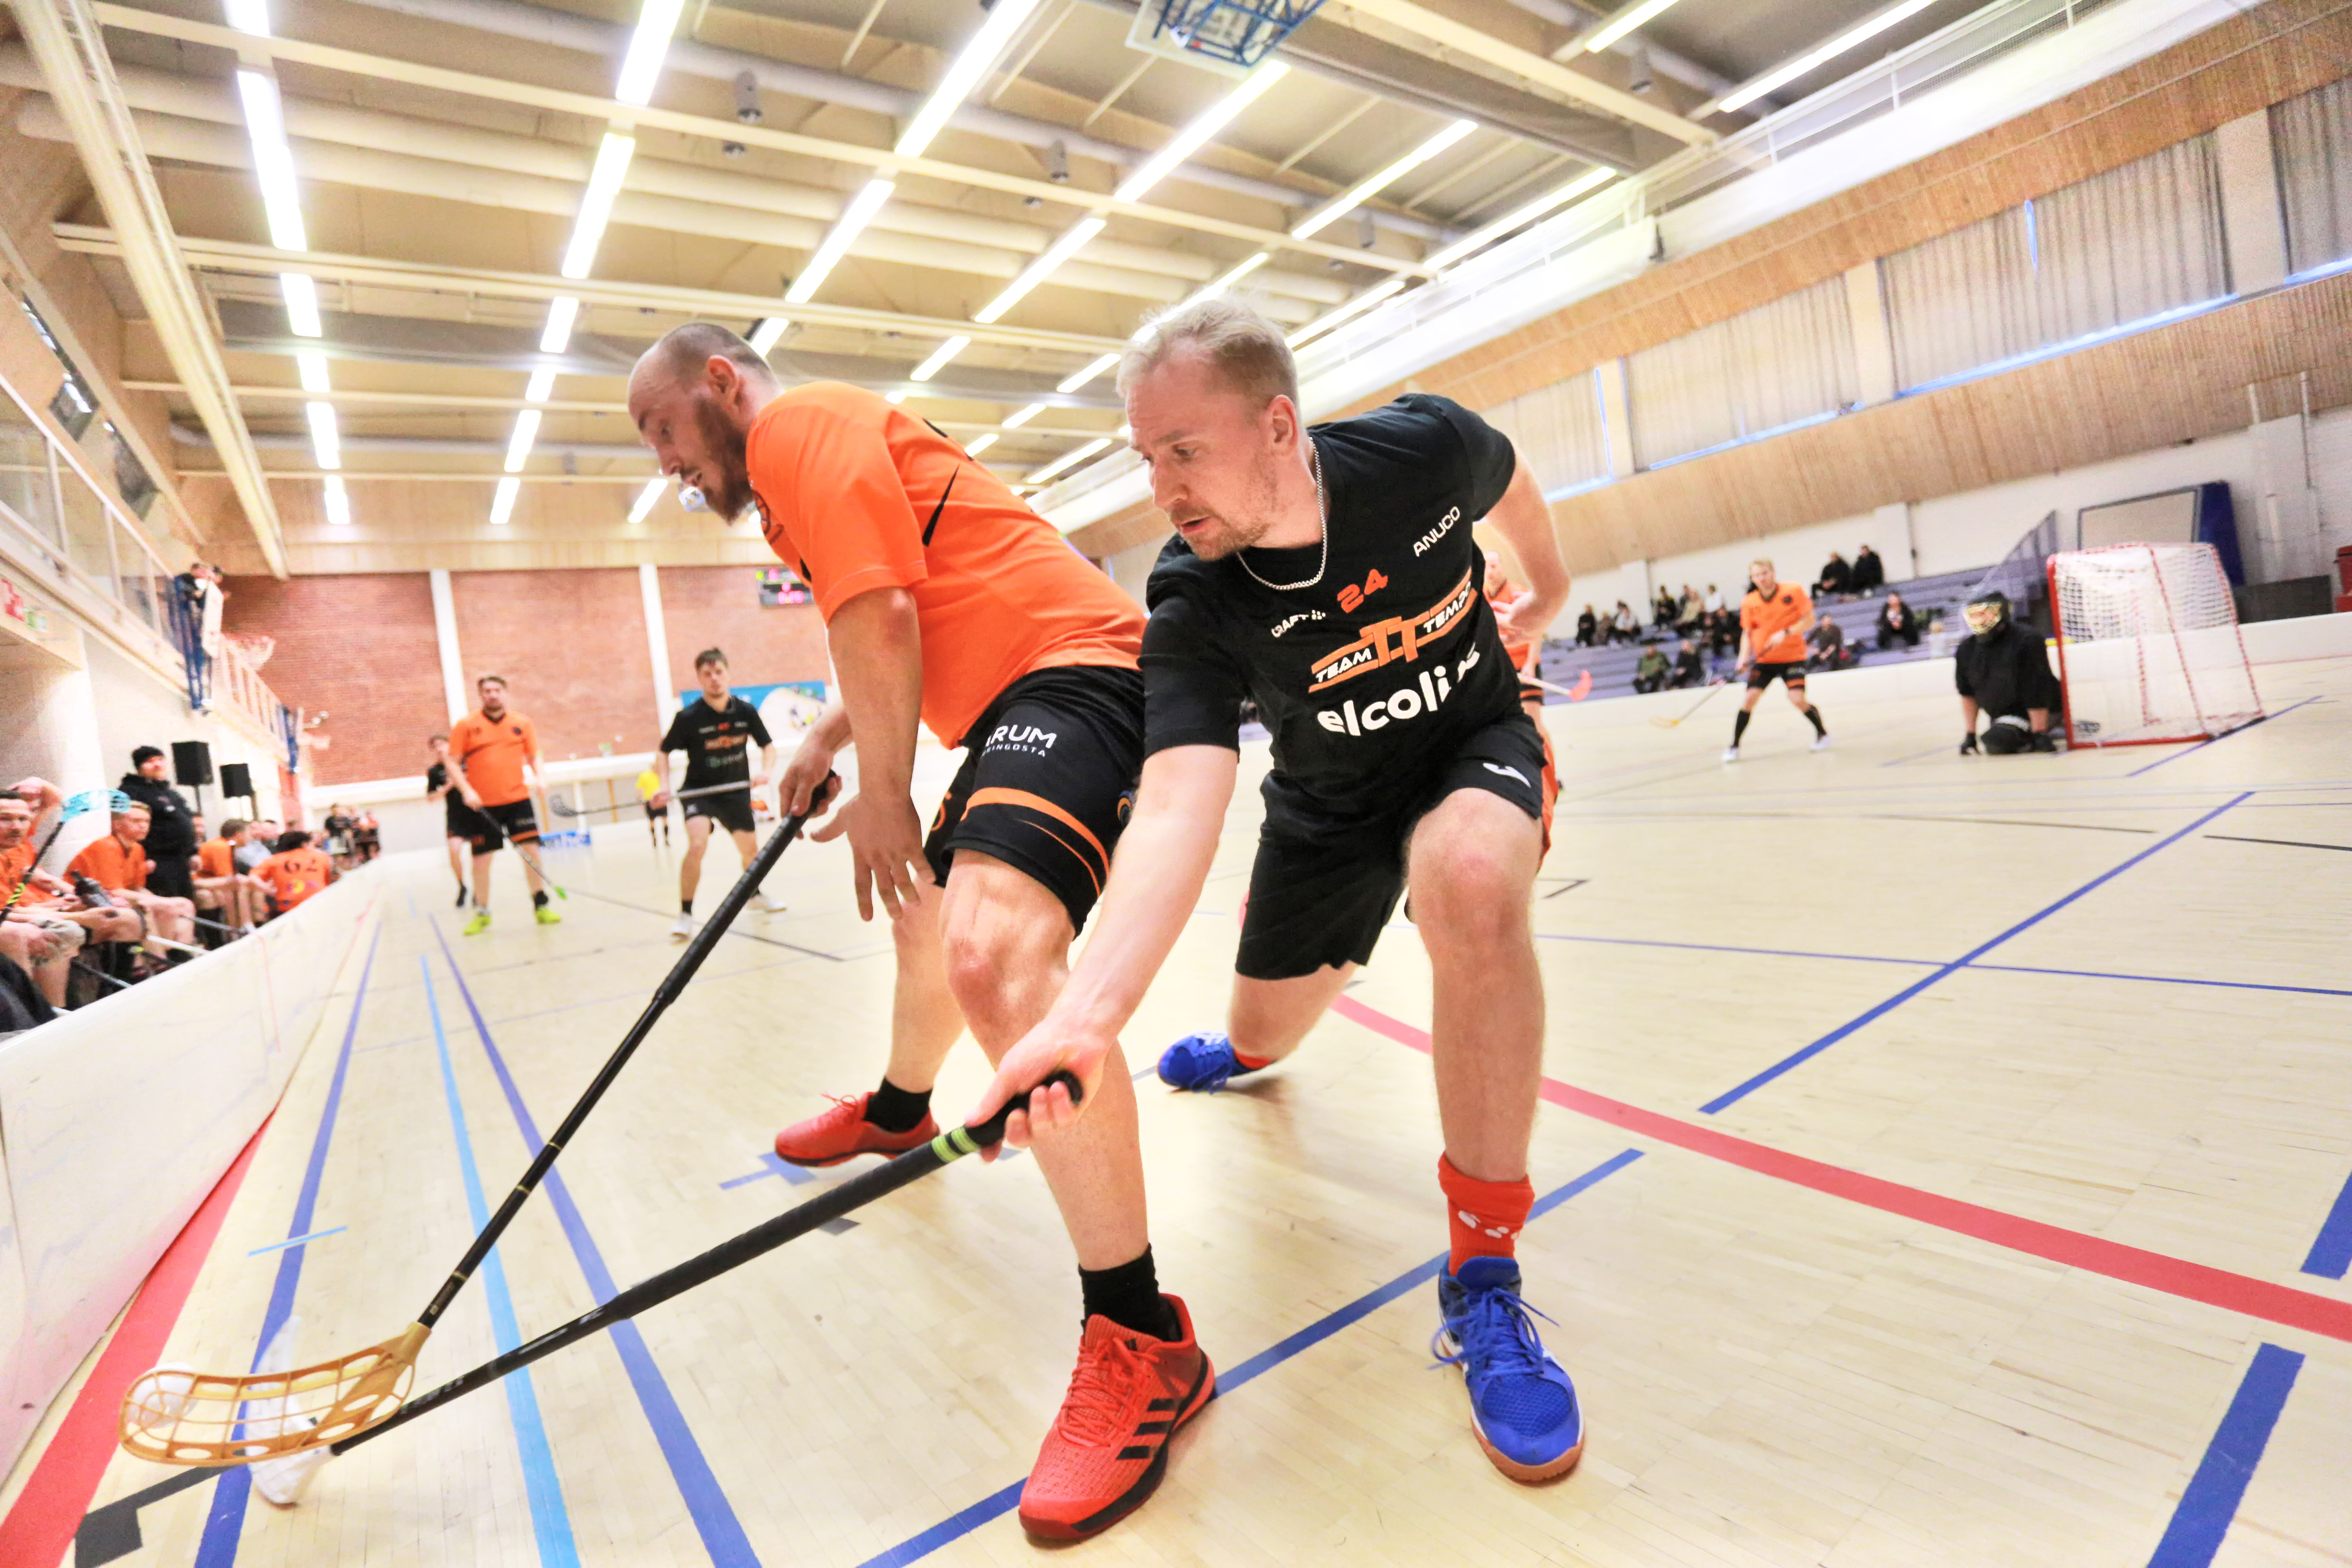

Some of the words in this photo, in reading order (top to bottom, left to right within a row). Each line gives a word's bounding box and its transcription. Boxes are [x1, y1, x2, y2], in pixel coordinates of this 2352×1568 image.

[1413, 506, 1460, 557] ANUCO
[1337, 568, 1388, 613] 24
[1316, 648, 1372, 683] TEAM
[985, 724, 1057, 748] RUM
